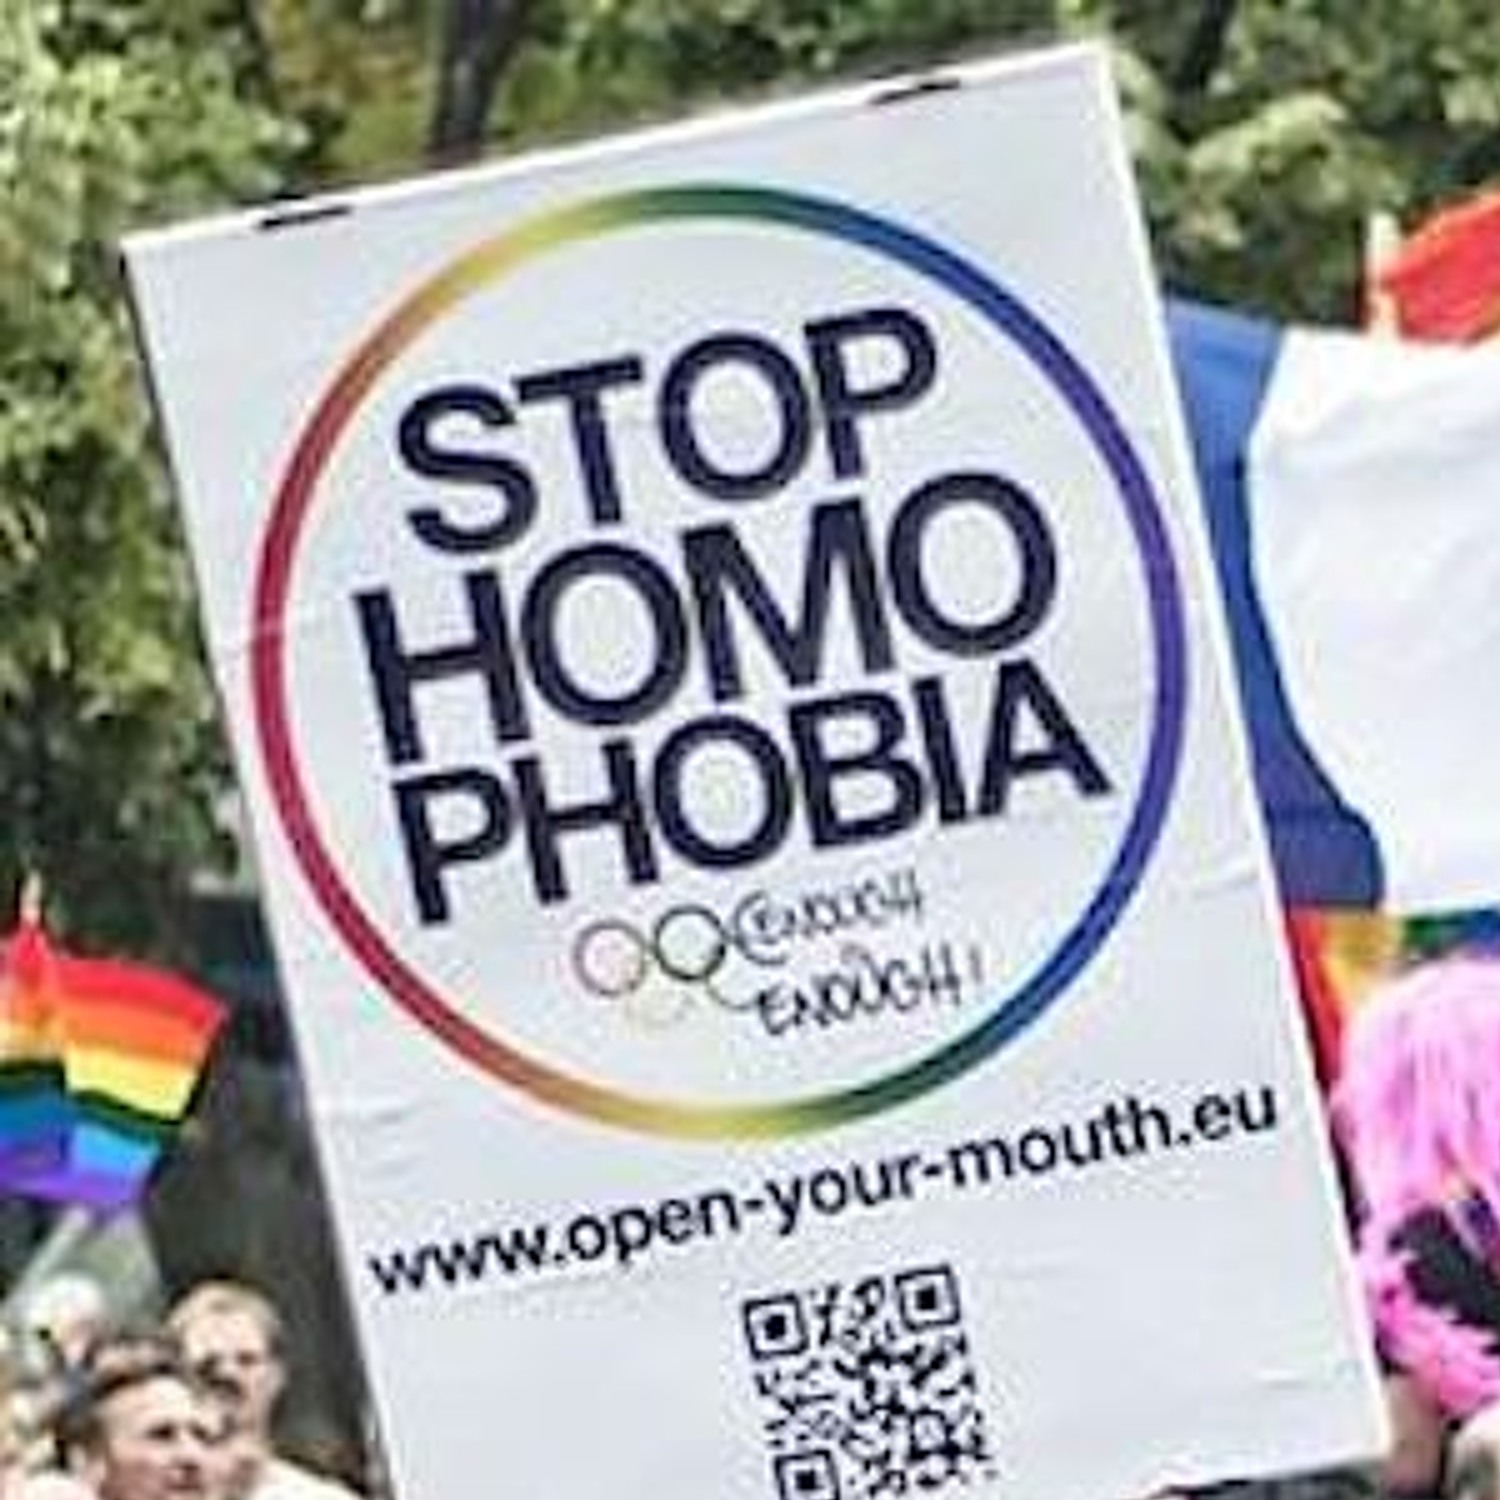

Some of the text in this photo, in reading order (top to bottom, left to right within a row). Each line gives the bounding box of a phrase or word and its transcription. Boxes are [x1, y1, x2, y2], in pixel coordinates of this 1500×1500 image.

[397, 308, 938, 554] STOP
[353, 471, 1057, 765] HOMO
[391, 659, 1113, 926] PHOBIA
[368, 1082, 1279, 1296] www.open-your-mouth.eu
